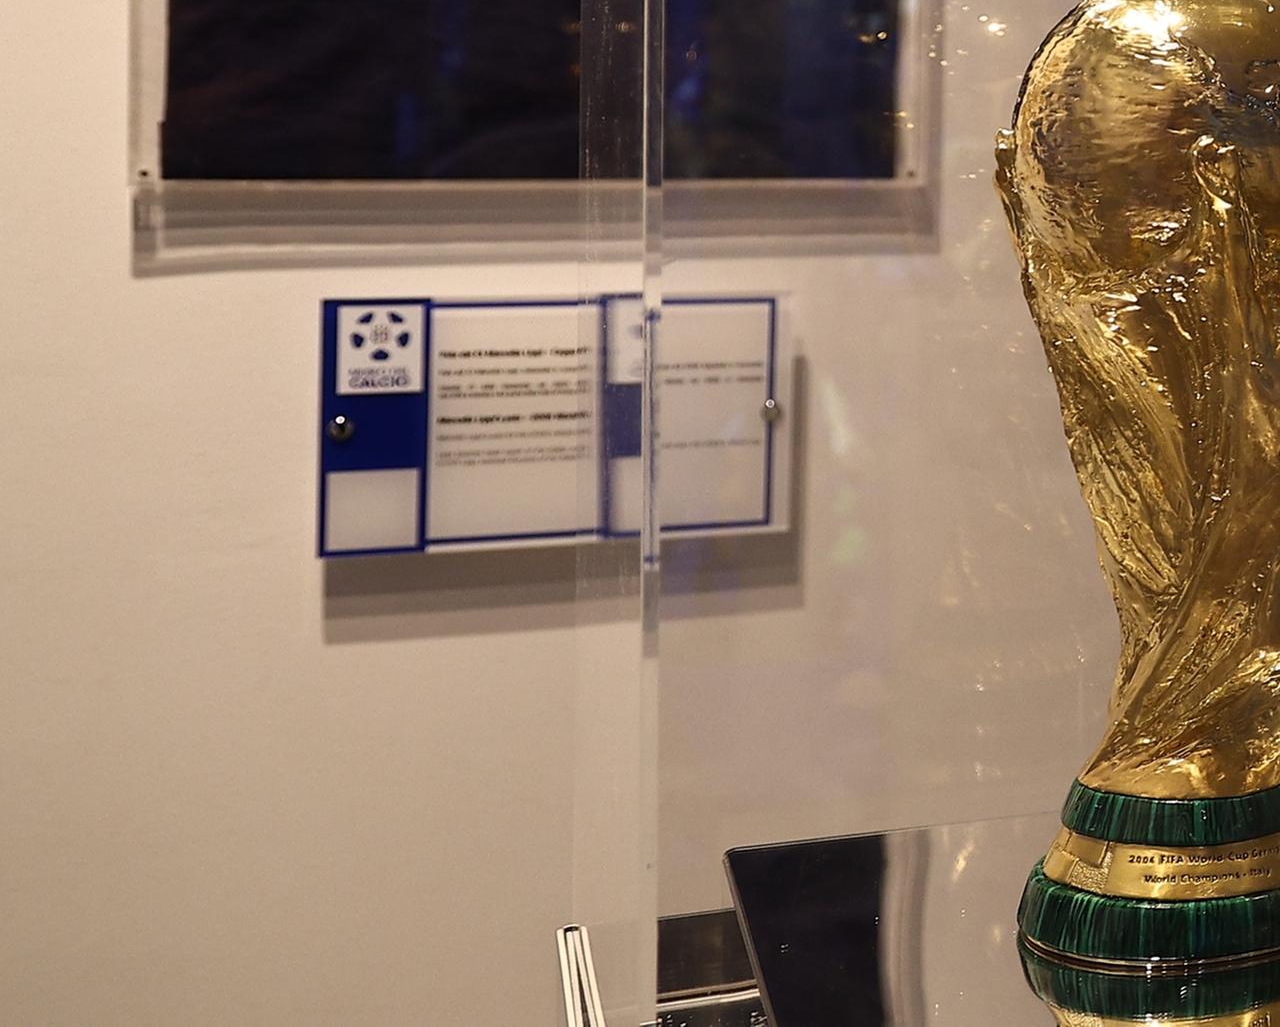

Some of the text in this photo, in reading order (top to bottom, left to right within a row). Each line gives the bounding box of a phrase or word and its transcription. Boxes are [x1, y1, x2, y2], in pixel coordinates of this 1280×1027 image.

[1159, 854, 1185, 865] FIFA
[1187, 854, 1225, 866] World
[1227, 850, 1249, 863] Cup
[1143, 874, 1177, 884] World
